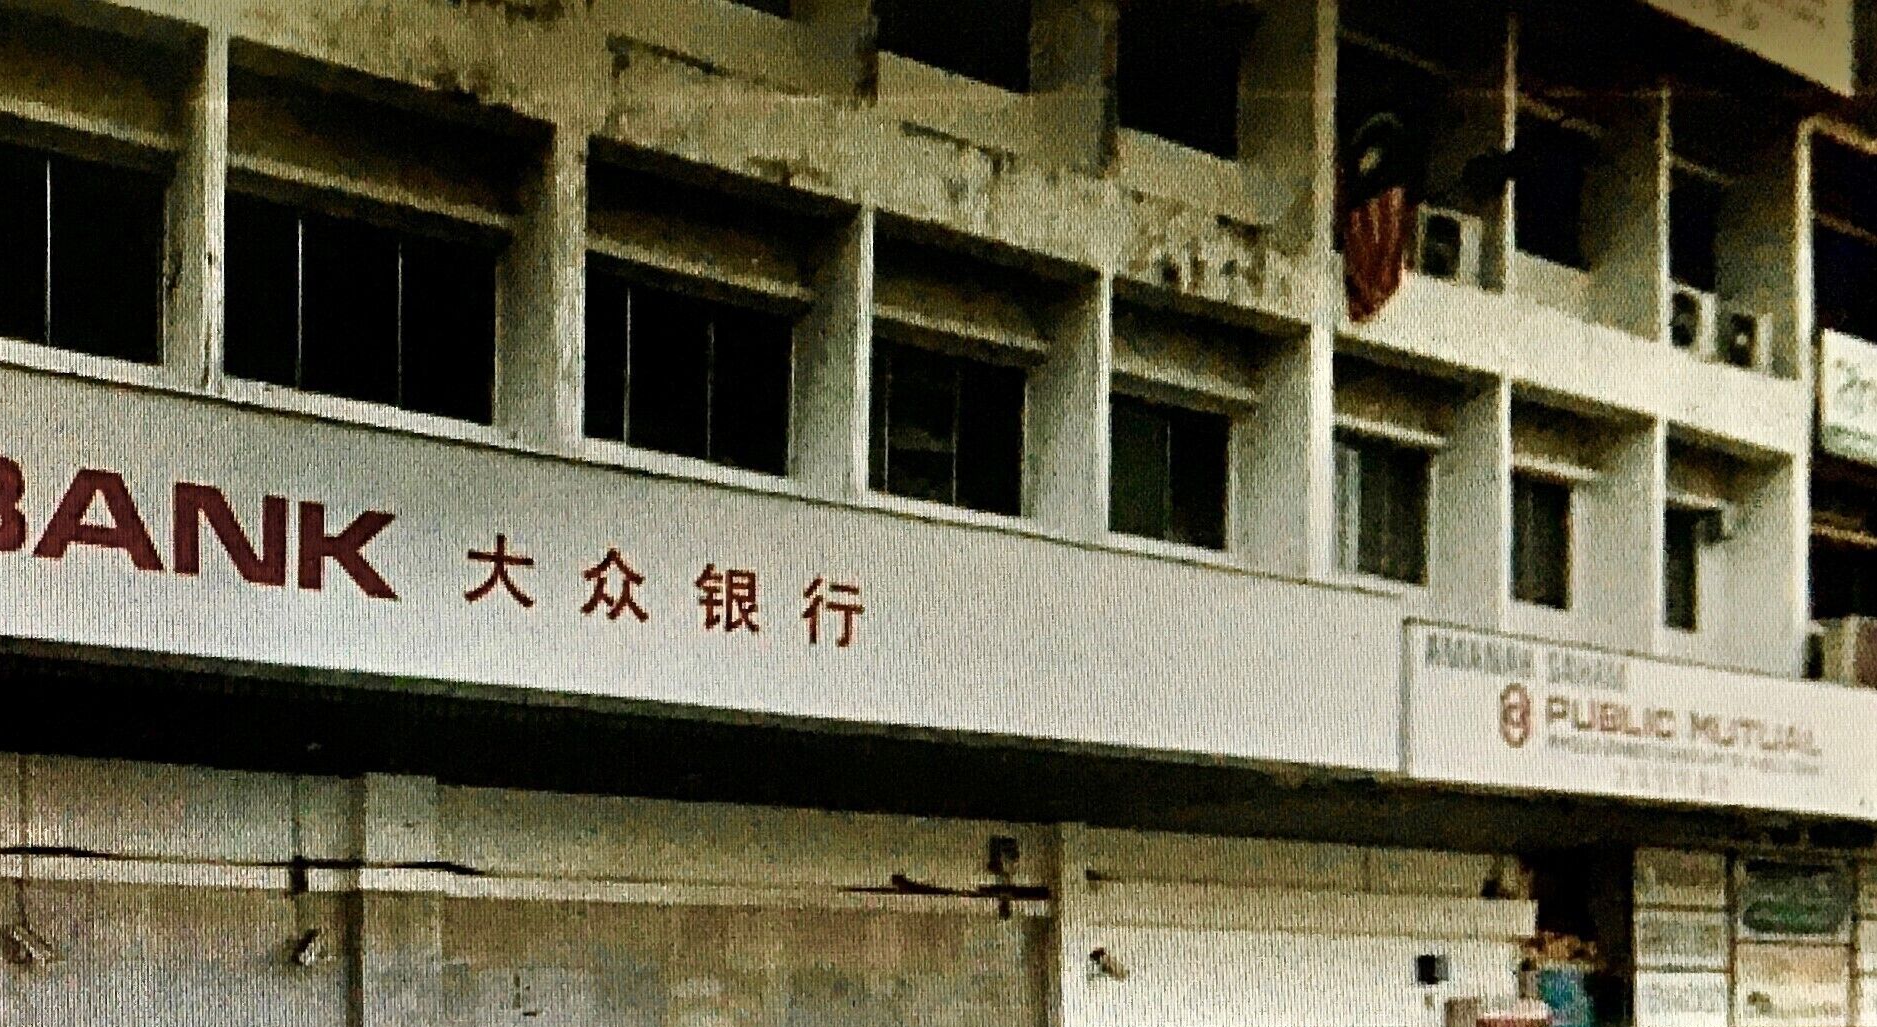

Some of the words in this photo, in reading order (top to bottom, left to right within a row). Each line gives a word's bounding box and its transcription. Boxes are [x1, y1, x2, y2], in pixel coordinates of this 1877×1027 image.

[465, 535, 866, 648] 大众银行
[1545, 695, 1674, 738] PUBLIC
[1689, 711, 1822, 756] MUTUAL
